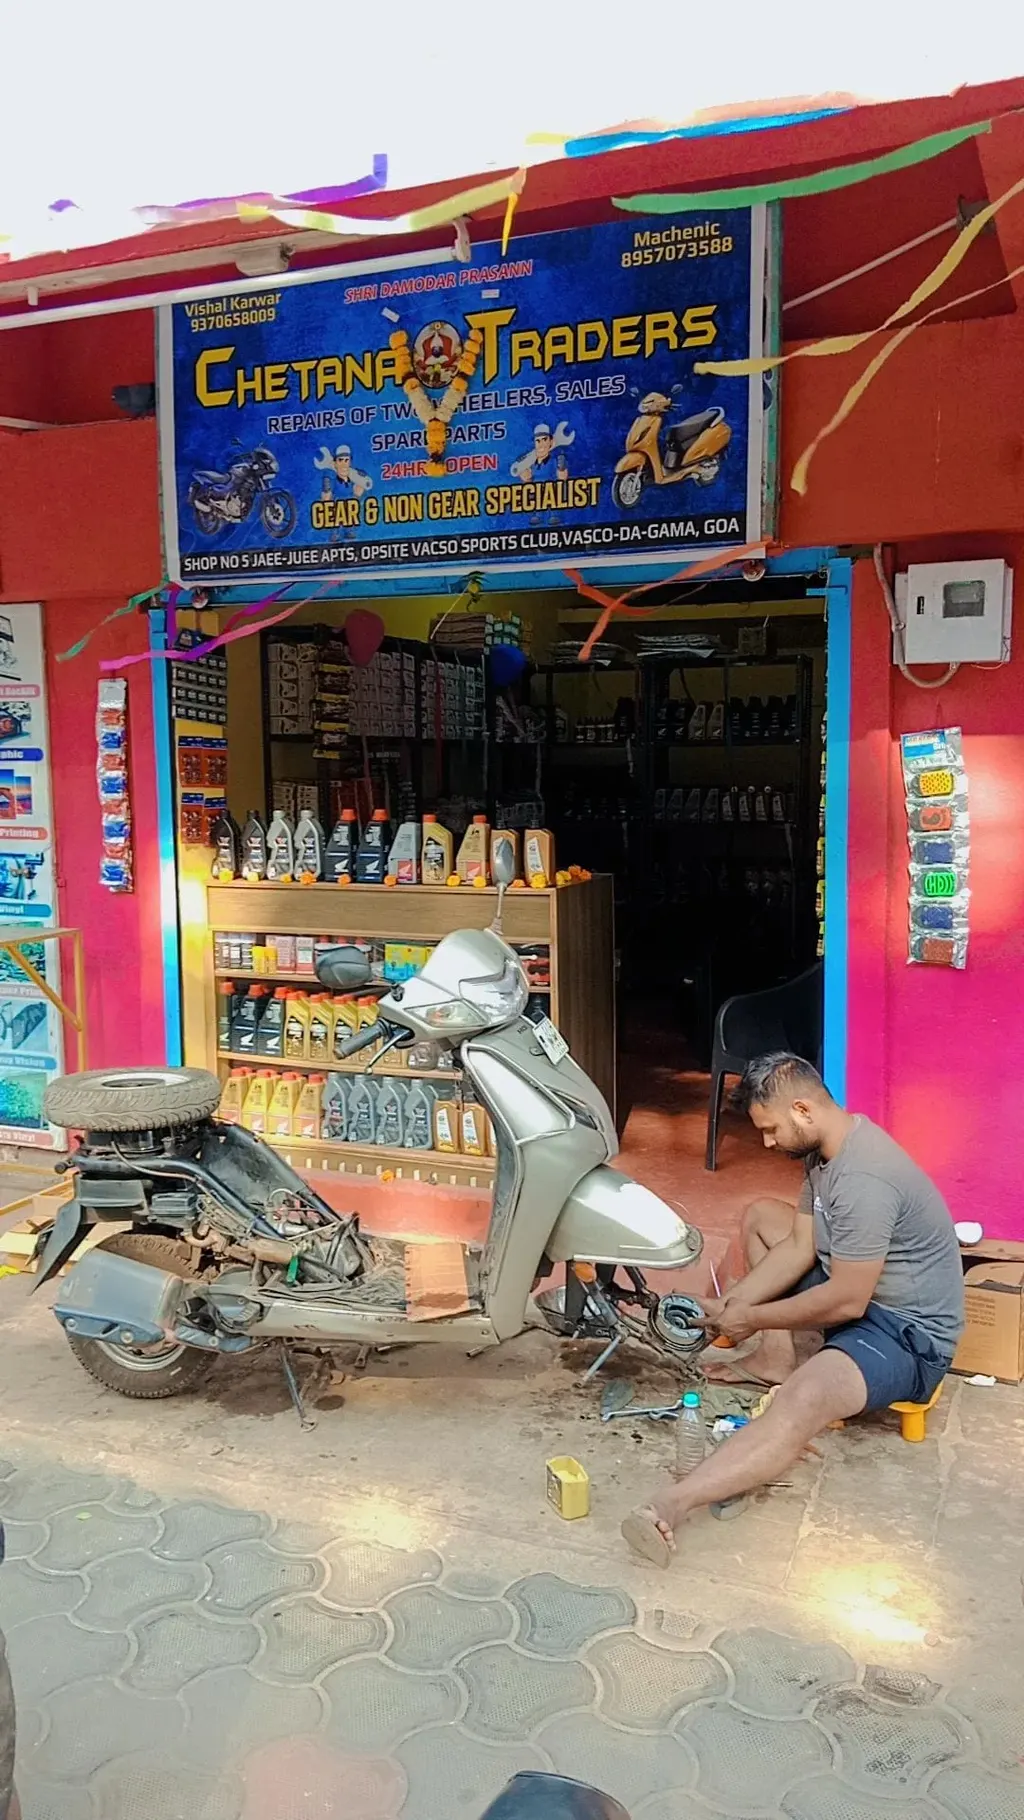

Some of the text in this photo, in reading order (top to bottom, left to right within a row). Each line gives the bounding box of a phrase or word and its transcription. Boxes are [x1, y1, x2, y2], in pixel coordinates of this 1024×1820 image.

[621, 236, 733, 268] 8957073588
[634, 221, 721, 248] Machenic
[344, 259, 533, 304] SHRI DAMODAR PRASANN
[184, 292, 281, 317] Vishal Karwar
[191, 307, 276, 332] 9370658009
[195, 304, 718, 408] CHETANA TRADERS
[267, 412, 346, 435] REPAIRS
[350, 405, 377, 425] OF
[383, 401, 418, 422] TW
[556, 374, 626, 402] SALES
[381, 454, 498, 480] 24HR OPEN
[311, 476, 602, 529] GEAR & NON GEAR SPECIALIST
[184, 557, 218, 572] SHOP
[220, 555, 239, 569] NO
[251, 550, 318, 567] JAEE-JUEE
[321, 547, 359, 564] APTS,
[361, 543, 409, 560] OPSITE
[411, 539, 458, 557] VACSO
[461, 535, 518, 552] SPORTS
[703, 517, 740, 536] GOA
